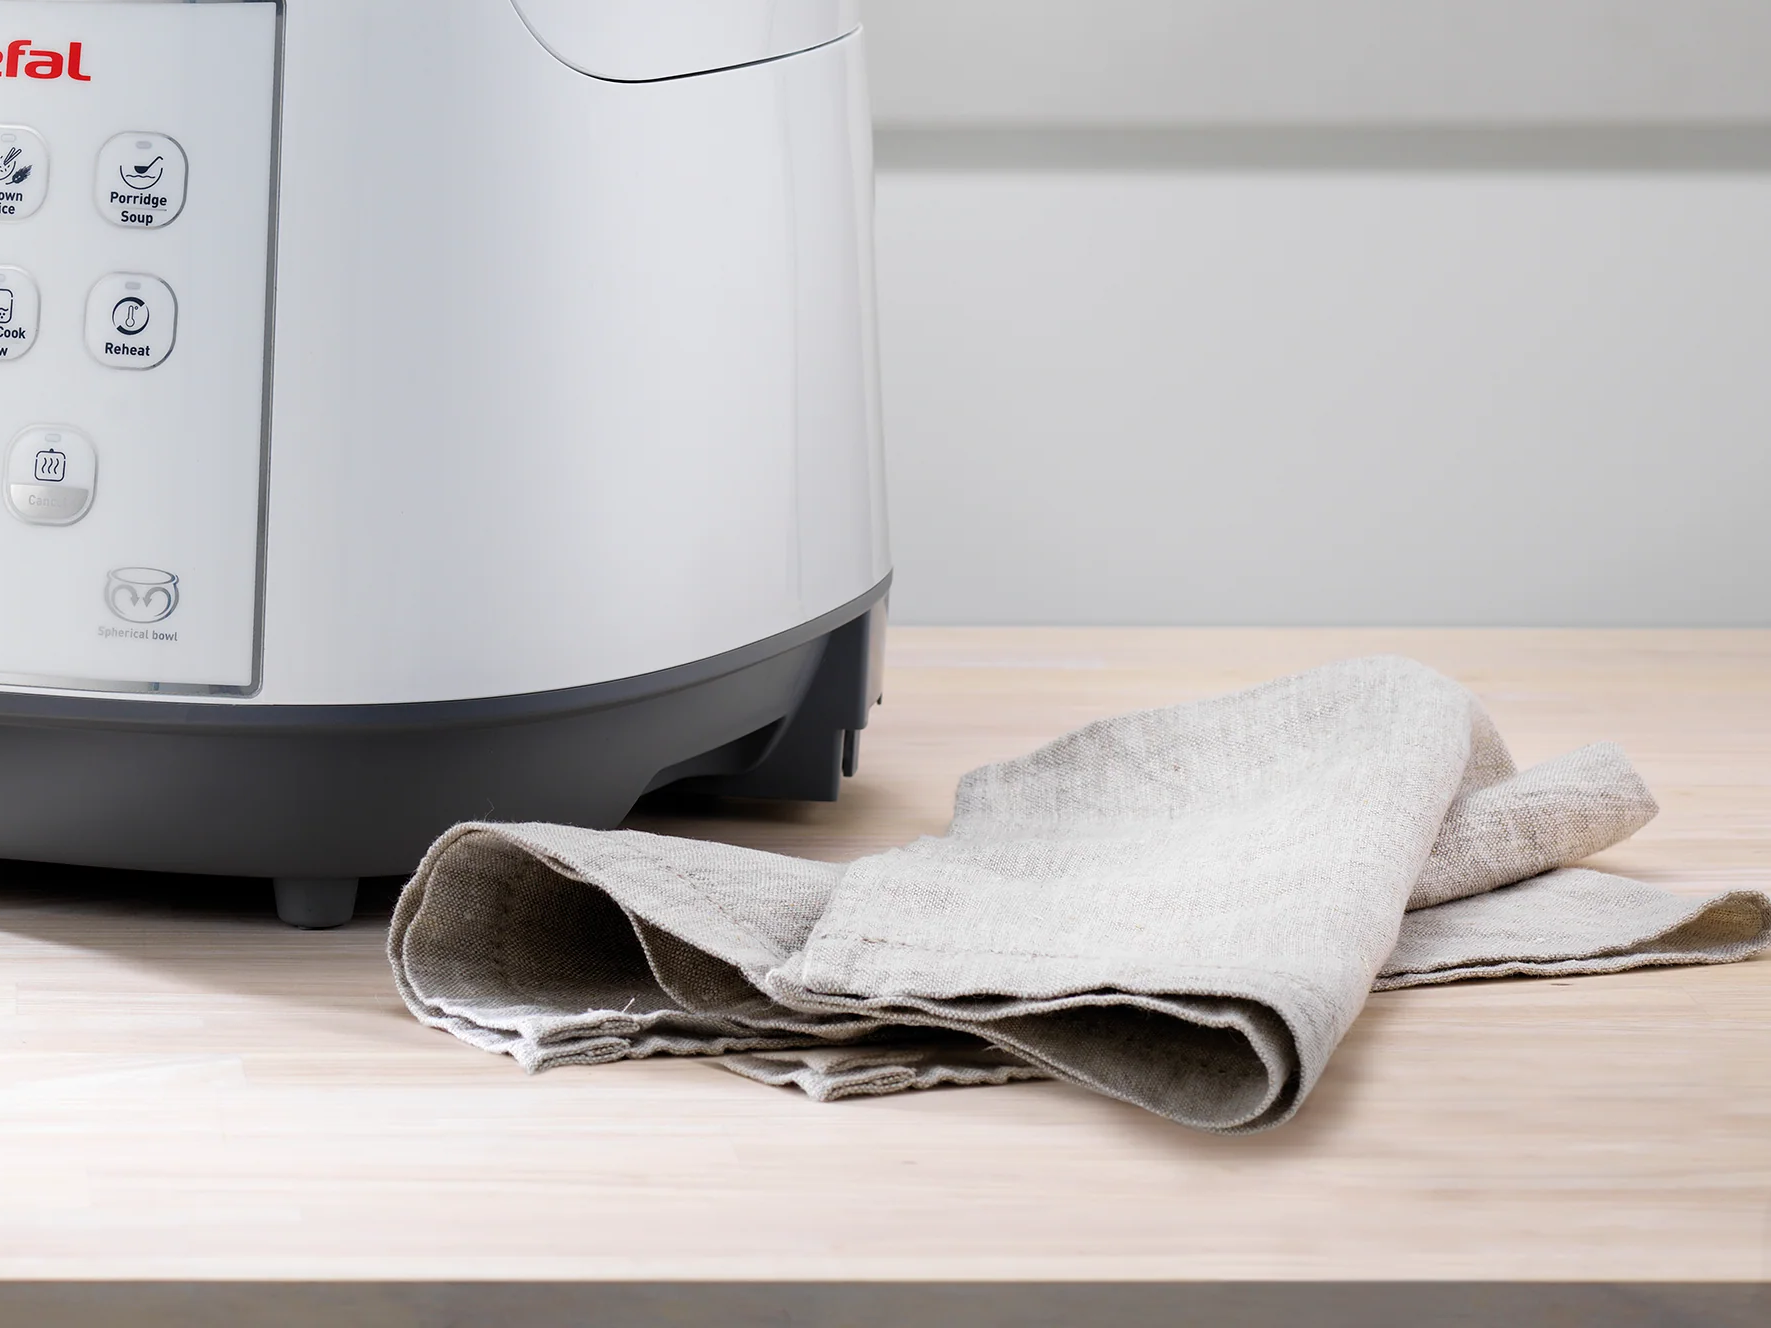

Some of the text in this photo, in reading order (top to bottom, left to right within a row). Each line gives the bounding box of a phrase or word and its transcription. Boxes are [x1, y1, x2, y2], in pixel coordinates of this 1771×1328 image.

[110, 191, 167, 208] Porridge
[121, 210, 153, 226] Soup
[105, 342, 150, 356] Reheat
[28, 494, 68, 509] Canc
[97, 626, 178, 641] Spherical bowl
